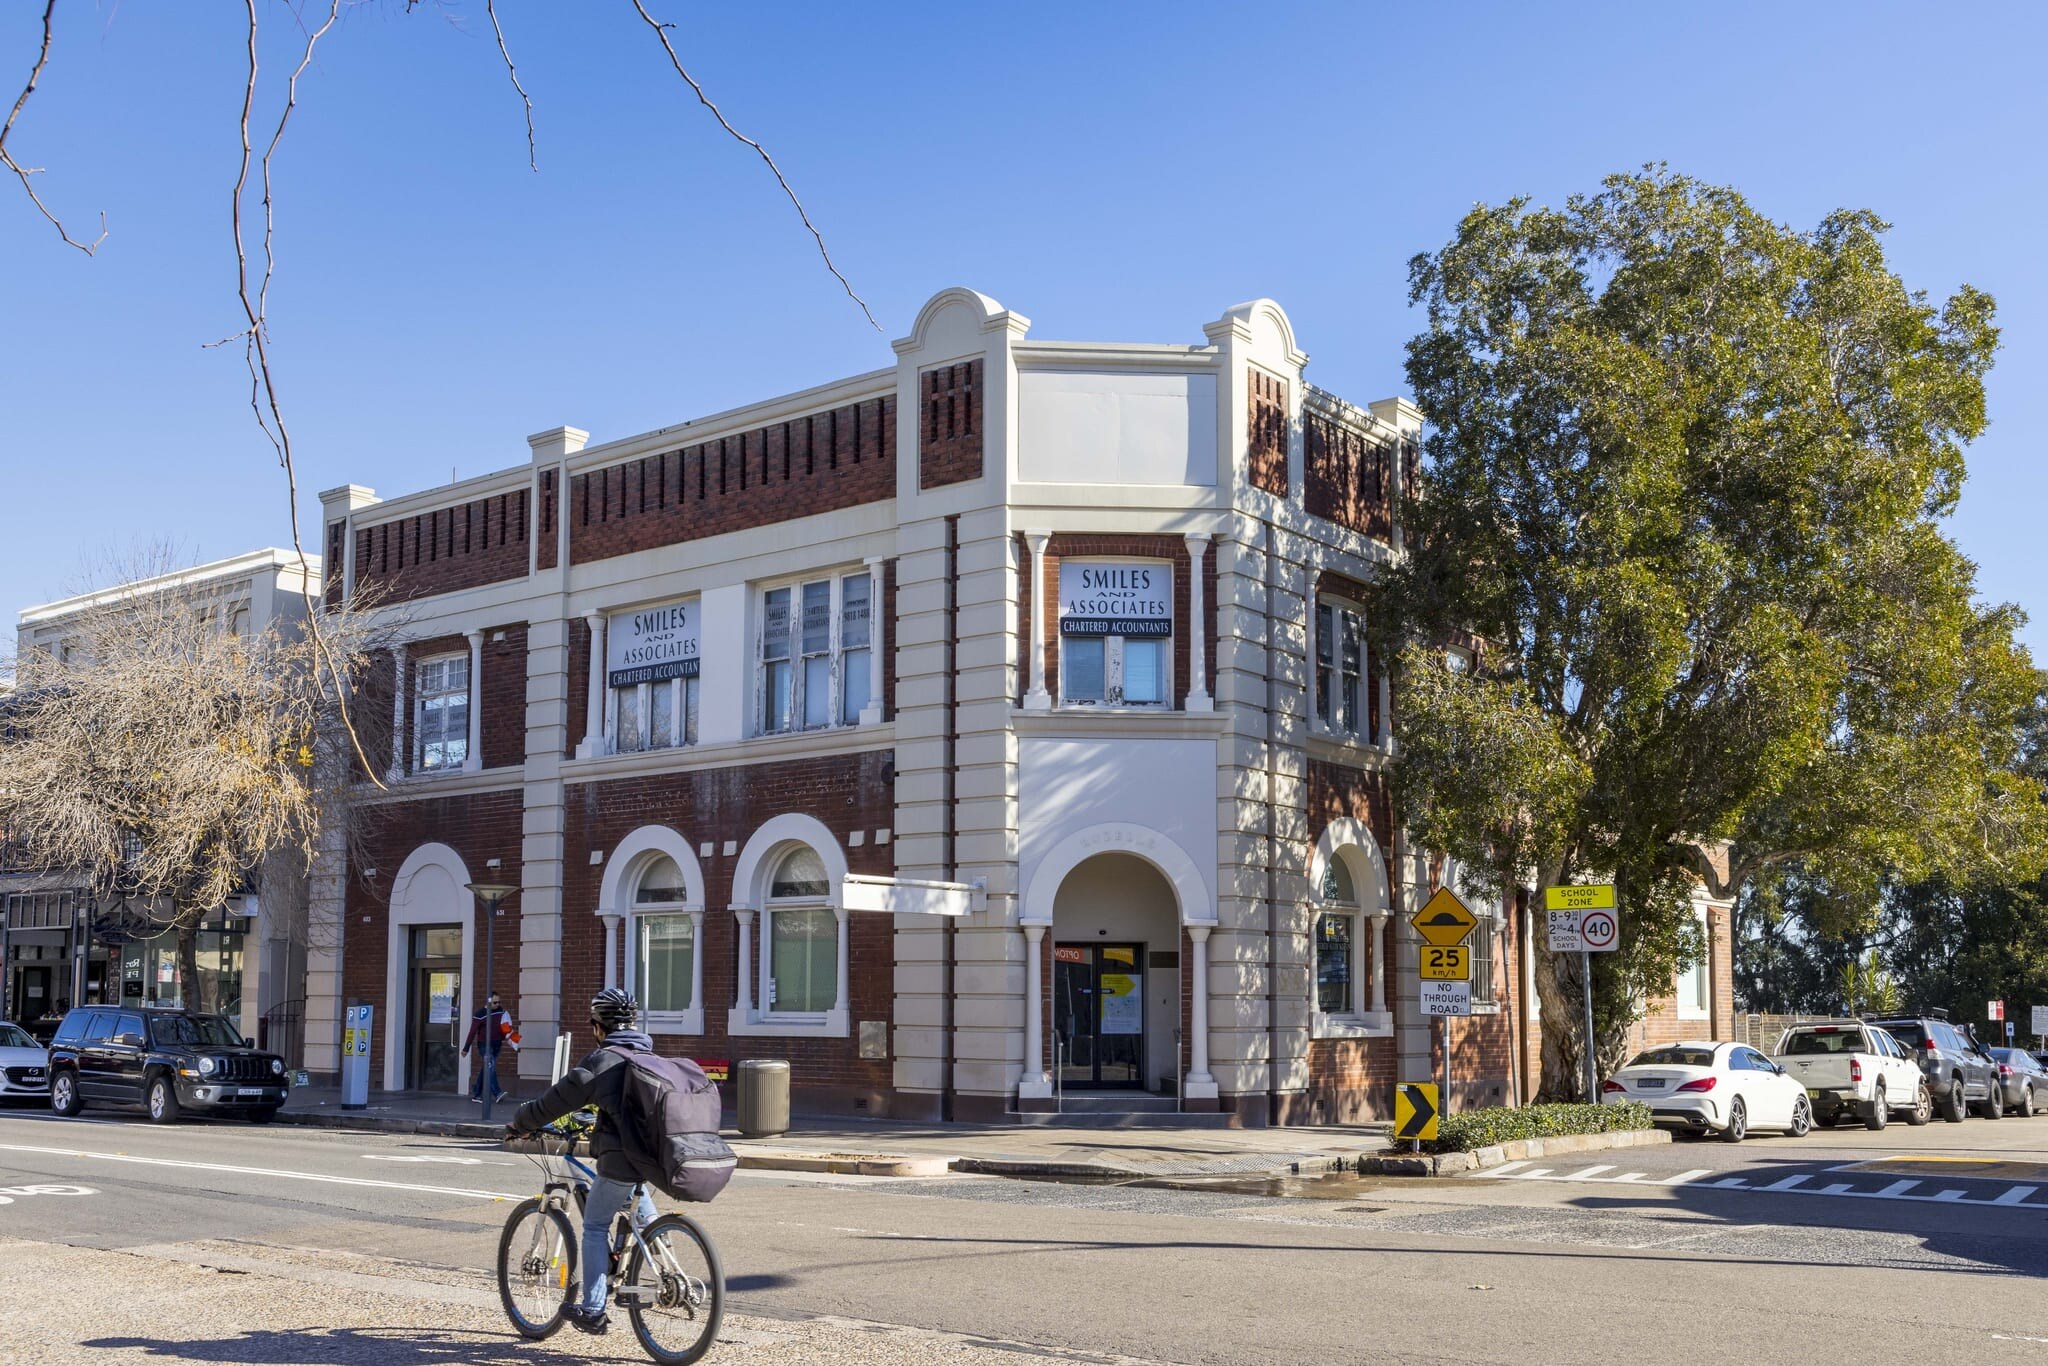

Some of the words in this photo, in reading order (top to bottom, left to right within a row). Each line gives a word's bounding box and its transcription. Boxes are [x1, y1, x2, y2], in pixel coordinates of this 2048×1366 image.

[1082, 569, 1150, 589] SMILES
[1068, 600, 1165, 615] ASSOCIATES
[634, 606, 686, 636] SMILES
[1063, 620, 1108, 632] CHARTERED
[1111, 621, 1169, 633] ACCOUNTANTS
[644, 633, 675, 643] AND
[623, 638, 696, 665] ASSOCIATES
[613, 668, 652, 685] CHARTERED
[1560, 889, 1599, 897] SCHOOL
[1567, 898, 1593, 906] ZONE
[1587, 922, 1610, 937] 40
[1429, 949, 1459, 967] 25
[1433, 969, 1456, 977] km/h
[1437, 983, 1452, 991] NO
[1424, 994, 1467, 1003] THROUGH
[1430, 1005, 1459, 1014] ROAD
